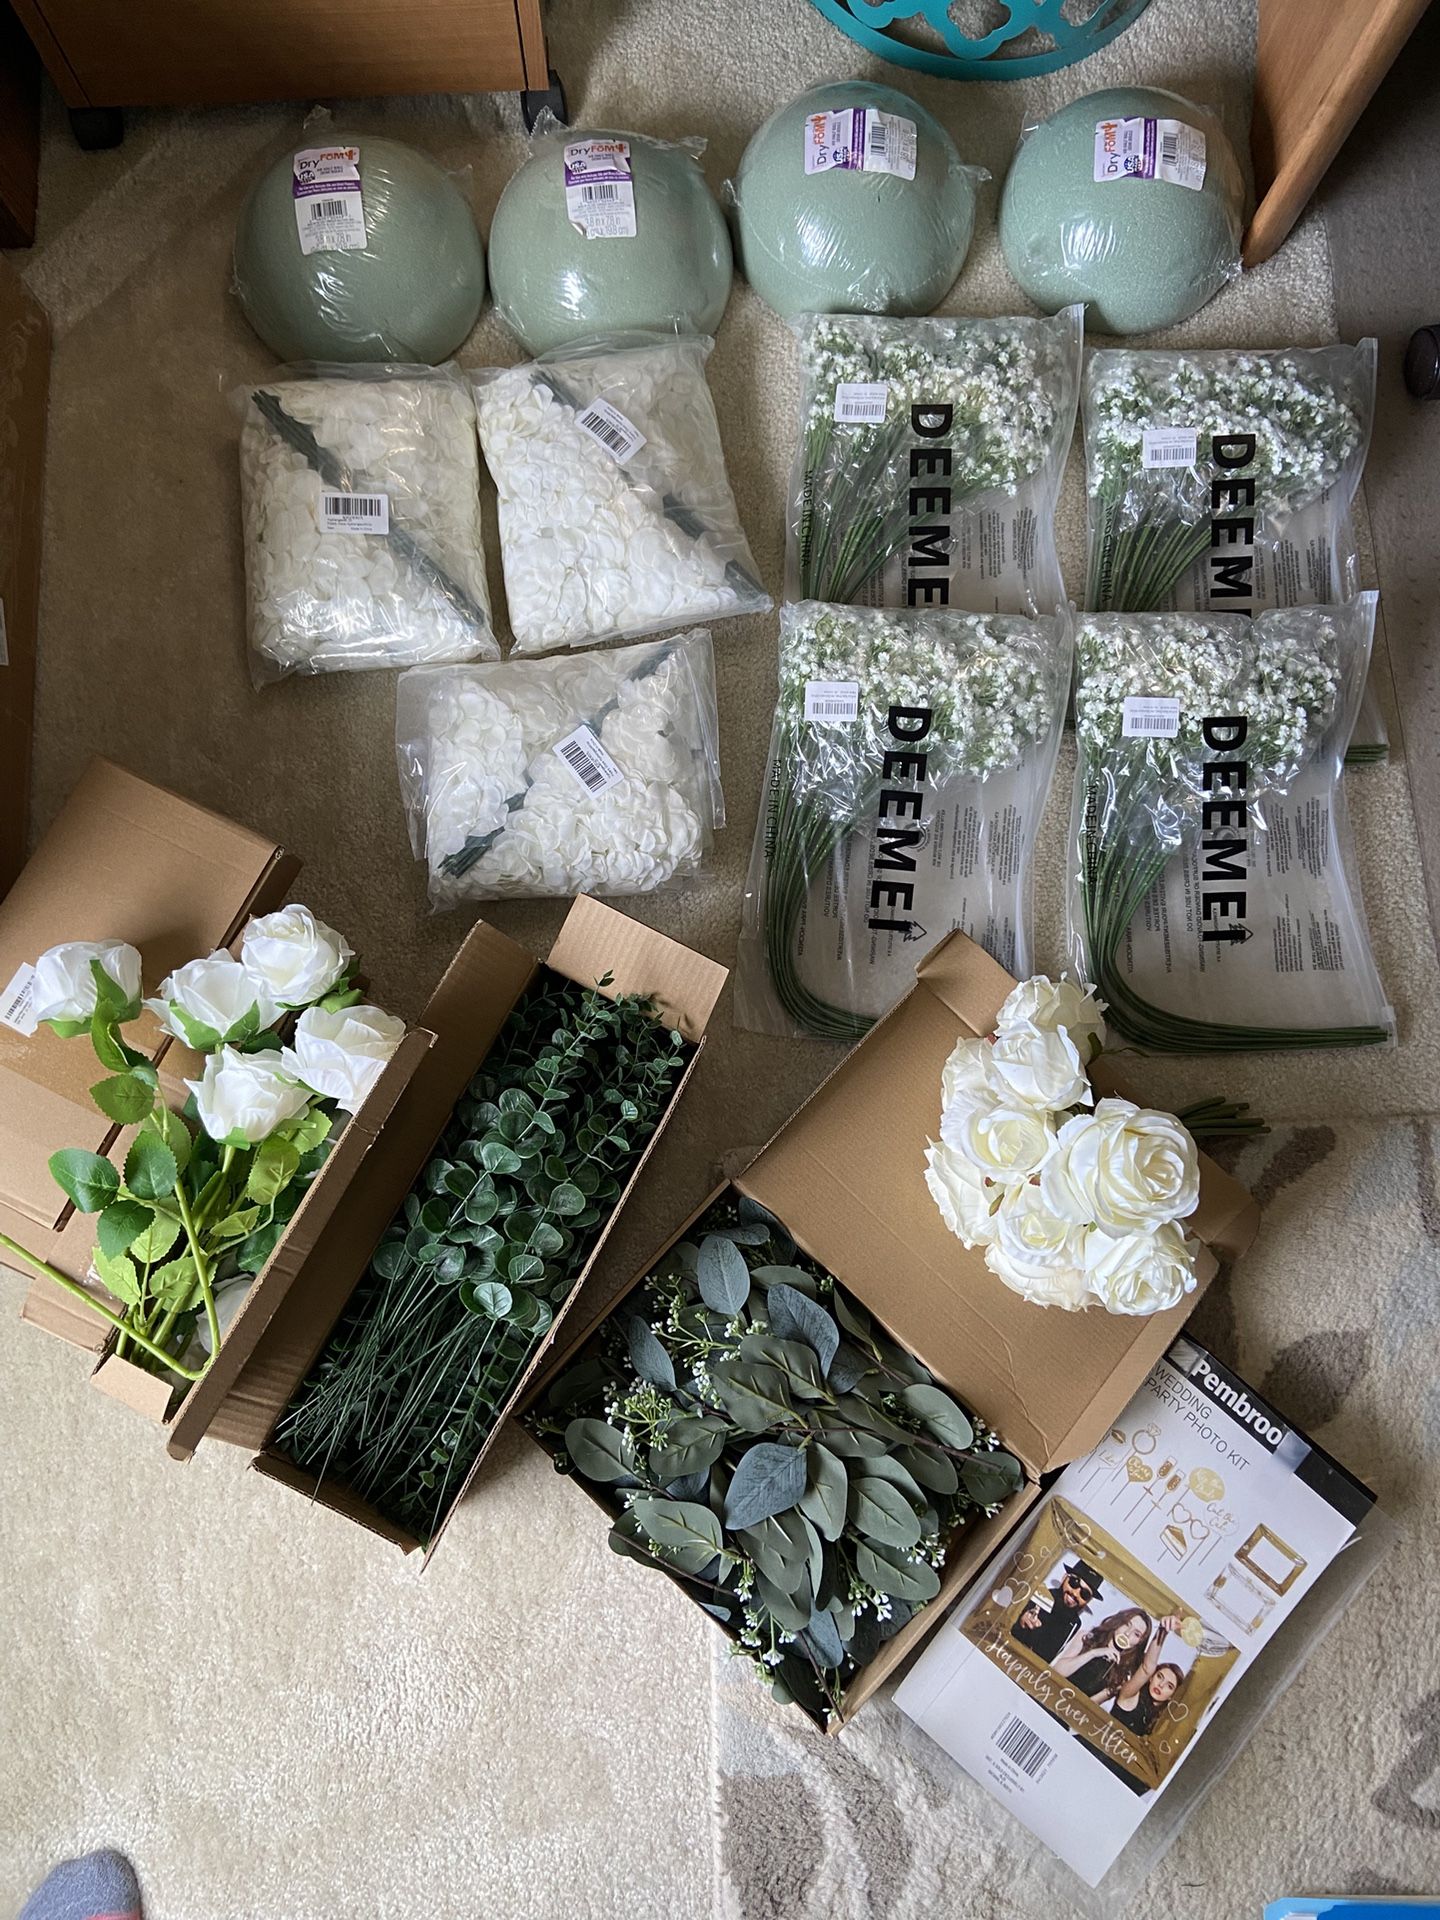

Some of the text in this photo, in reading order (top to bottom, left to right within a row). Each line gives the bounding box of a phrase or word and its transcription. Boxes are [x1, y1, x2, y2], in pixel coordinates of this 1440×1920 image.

[801, 470, 813, 568] MADE IN CHINA
[908, 403, 953, 606] DEEME
[1210, 434, 1256, 617] DEEM
[1101, 561, 1112, 602] CHINA
[764, 760, 781, 858] MADE IN CHINA
[867, 705, 933, 932] DEEMEI
[1086, 785, 1097, 826] MADE
[1086, 827, 1097, 839] IN
[1201, 716, 1248, 943] DEEMEI
[1144, 1378, 1250, 1471] PARTY PHOTO KIT
[1153, 1364, 1213, 1420] WEDDING
[1191, 1359, 1284, 1446] Pembroo
[985, 1631, 1138, 1765] Happily Ever After
